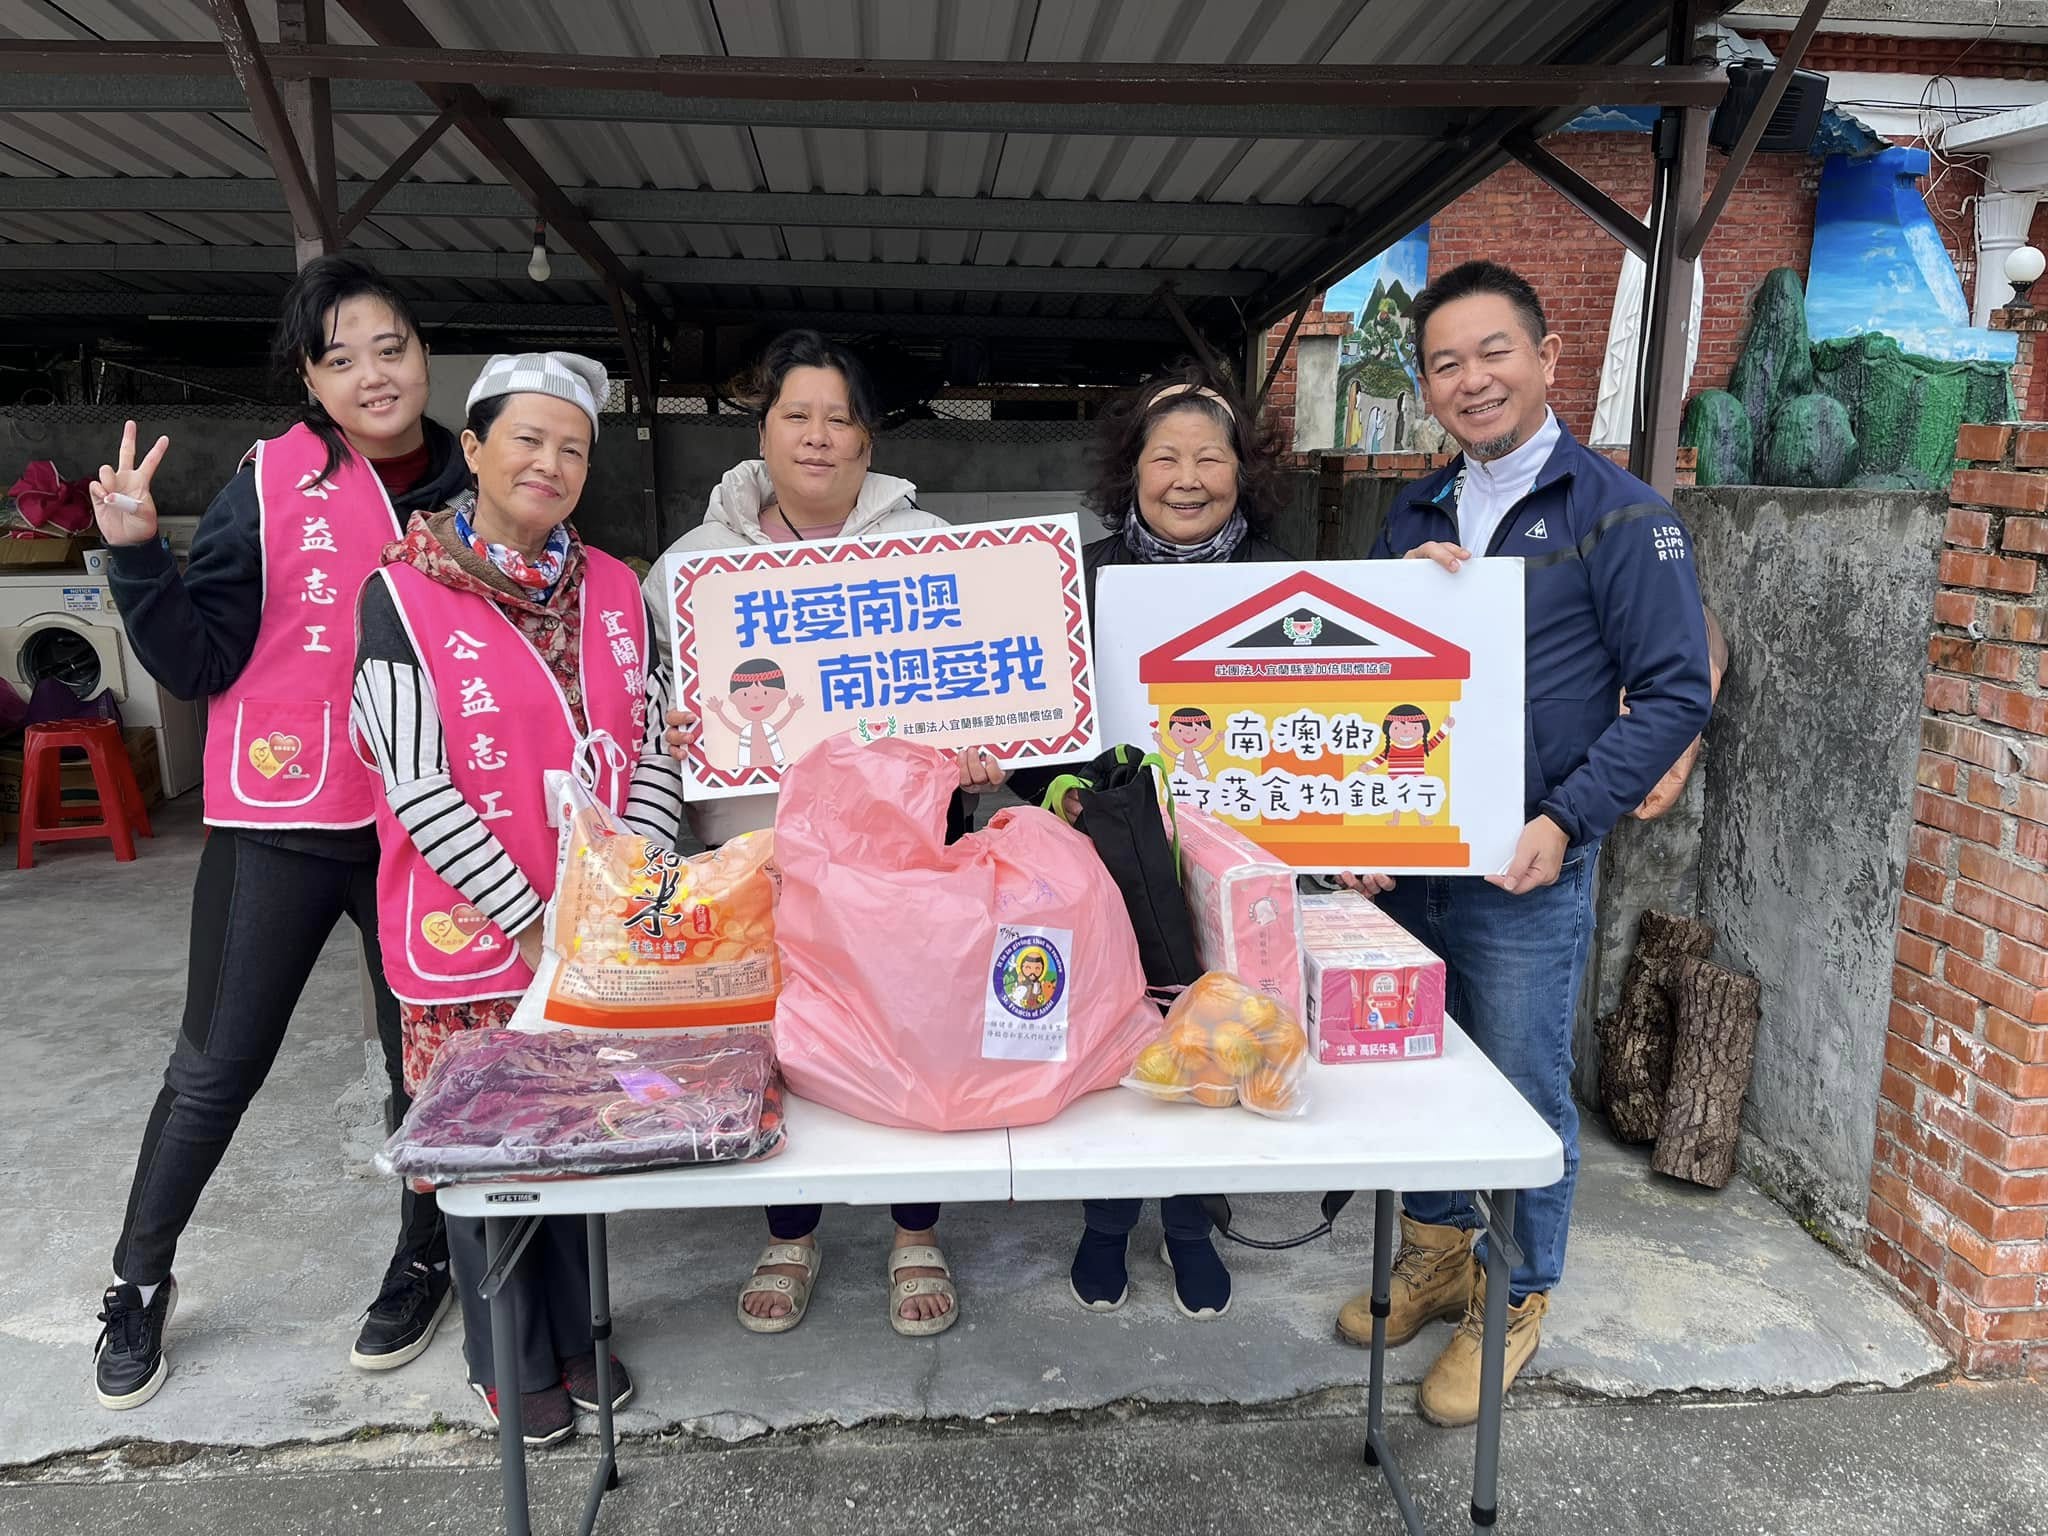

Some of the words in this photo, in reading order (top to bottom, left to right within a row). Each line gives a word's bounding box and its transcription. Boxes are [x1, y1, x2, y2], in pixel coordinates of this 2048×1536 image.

[295, 469, 341, 653] 公益志工
[733, 573, 962, 648] 我愛南澳
[817, 635, 1047, 712] 南澳愛我
[1215, 662, 1392, 677] 社團法人宜蘭縣愛加倍關懷協會
[444, 629, 513, 821] 公益志工
[903, 707, 1064, 735] 社團法人宜蘭縣愛加倍關懷協會
[1231, 716, 1373, 755] 南澳鄉
[1359, 1042, 1398, 1056] 高鈣牛乳
